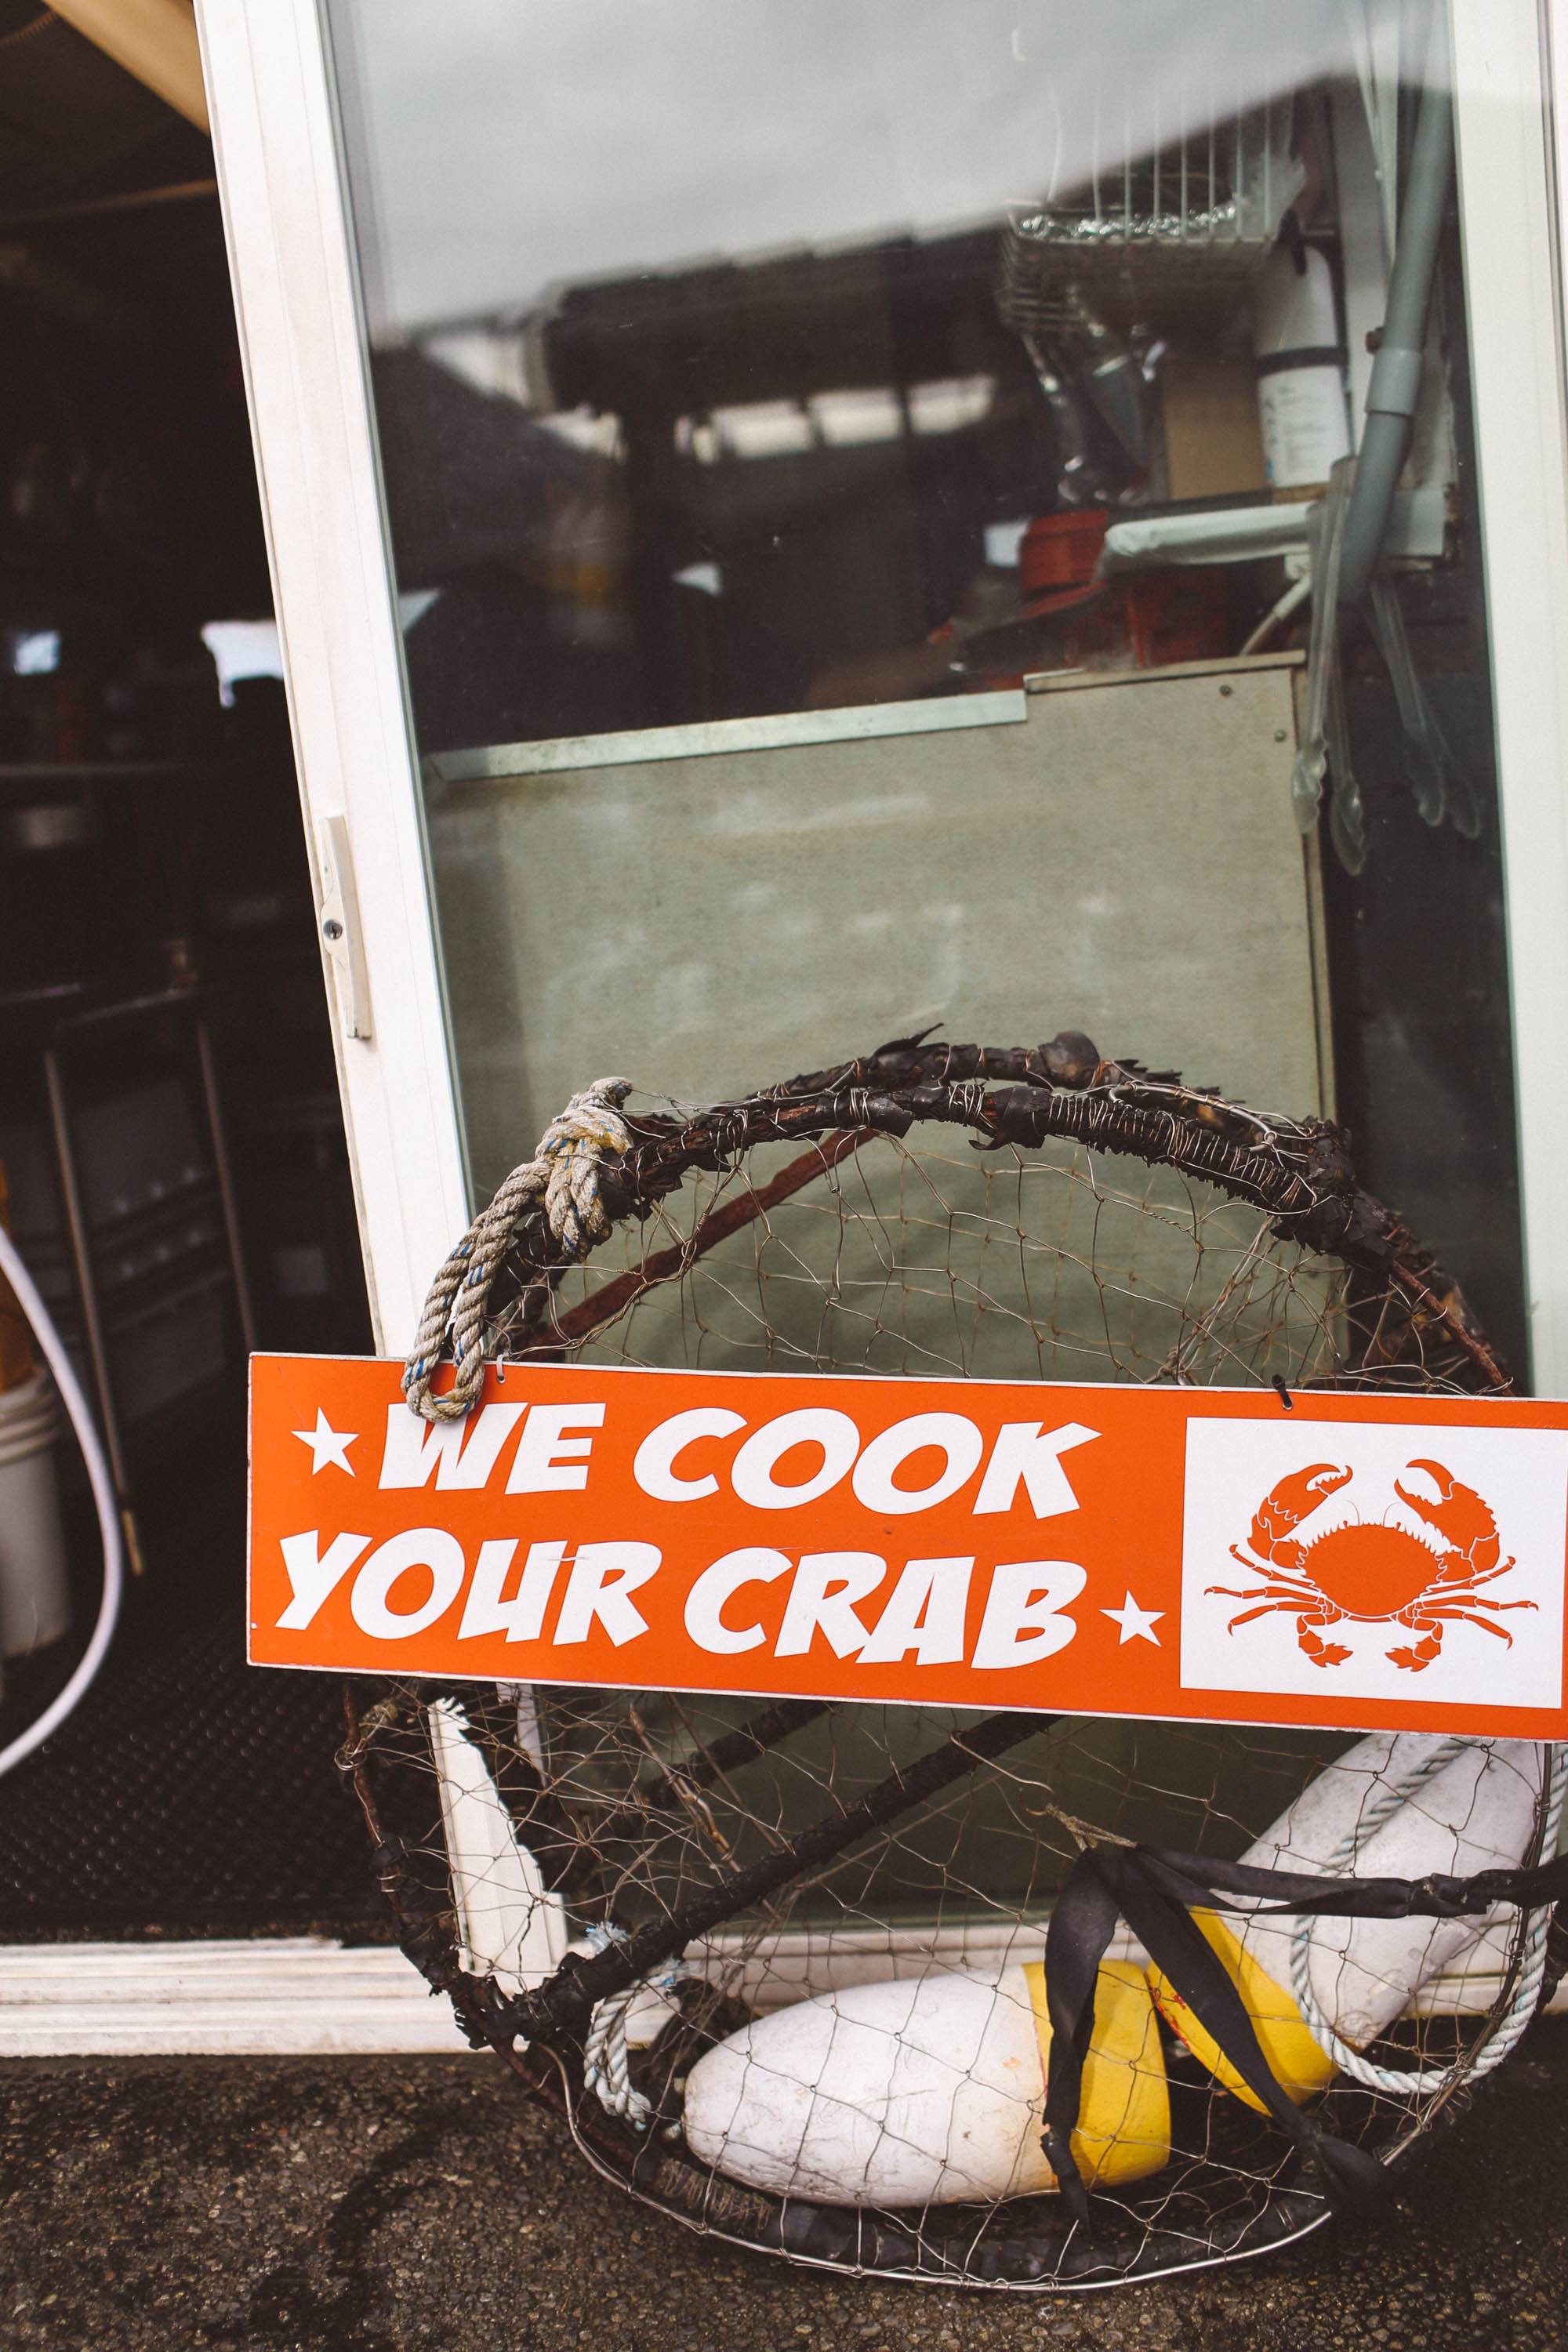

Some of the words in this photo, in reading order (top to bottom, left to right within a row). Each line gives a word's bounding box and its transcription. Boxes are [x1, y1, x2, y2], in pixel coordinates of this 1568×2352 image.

[378, 1402, 606, 1495] WE
[633, 1407, 1102, 1519] COOK
[275, 1527, 662, 1647] YOUR
[684, 1547, 1087, 1669] CRAB
